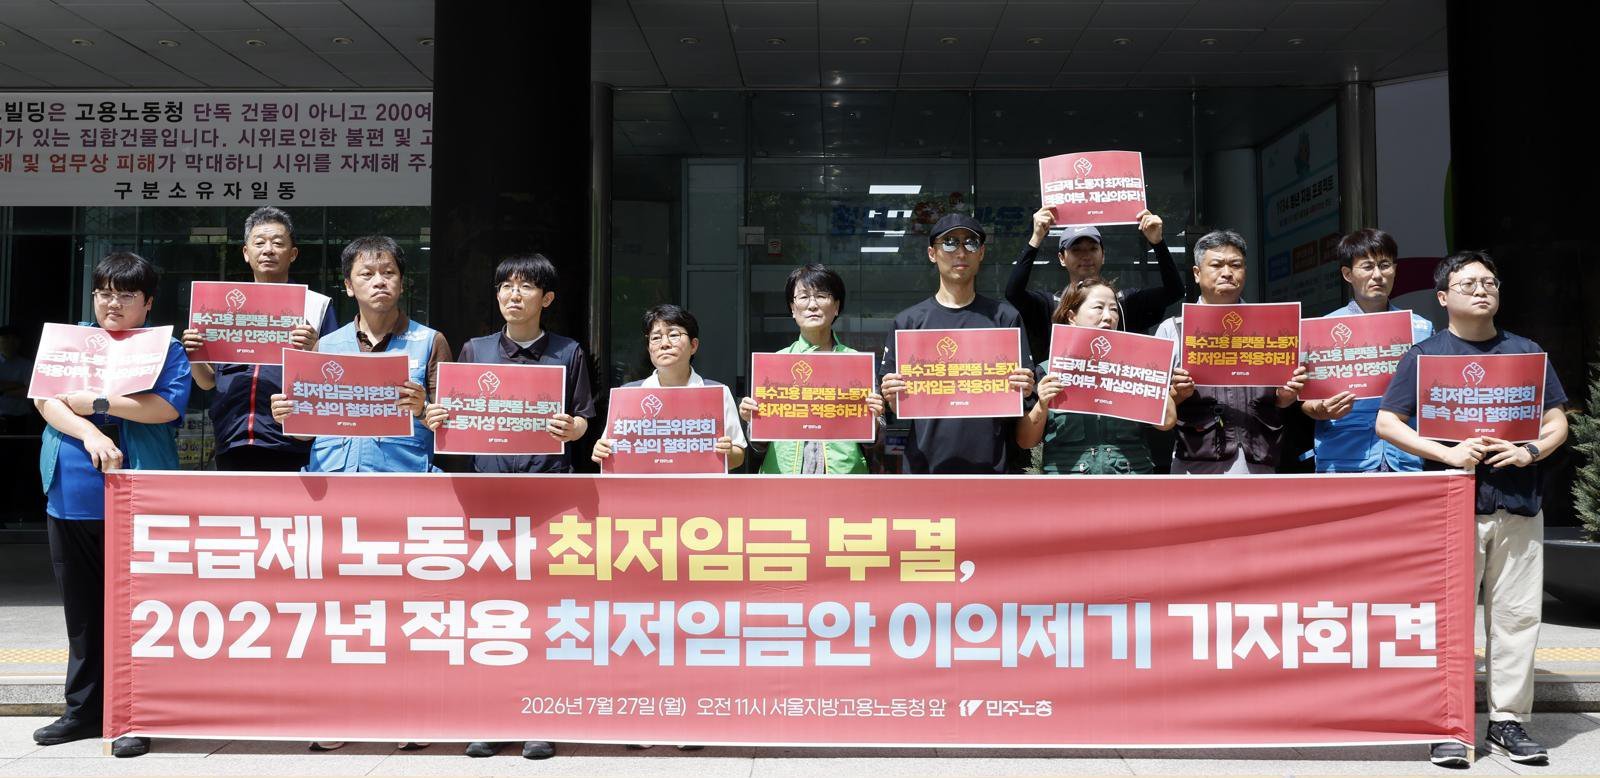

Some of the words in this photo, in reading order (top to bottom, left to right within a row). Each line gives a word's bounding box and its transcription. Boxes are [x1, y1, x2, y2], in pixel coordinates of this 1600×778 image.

[0, 102, 67, 123] 빌딩은
[74, 102, 183, 123] 고용노동청
[194, 103, 232, 122] 단독
[241, 103, 299, 122] 건물이
[309, 103, 367, 122] 아니고
[375, 103, 432, 121] 200여
[0, 128, 23, 147] 가
[33, 128, 70, 147] 있는
[80, 128, 227, 147] 집합건물입니다.
[238, 128, 337, 147] 시위로인한
[346, 128, 384, 147] 불편
[394, 128, 411, 147] 및
[22, 154, 39, 173] 및
[49, 154, 108, 173] 업무상
[116, 153, 176, 173] 피해가
[185, 154, 263, 173] 막대하니
[273, 154, 331, 173] 시위를
[340, 153, 399, 173] 자제해
[407, 154, 432, 172] 주
[1045, 179, 1073, 192] 도급제
[1074, 178, 1104, 190] 노동자
[1104, 177, 1142, 189] 최저임금
[192, 312, 234, 327] 특수고용
[236, 314, 268, 327] 플랫폼
[270, 315, 304, 328] 노동자
[1185, 335, 1229, 349] 특수고용
[1231, 335, 1265, 349] 플랫폼
[1265, 335, 1298, 349] 노동자
[1188, 352, 1238, 366] 최저임금
[1344, 346, 1377, 361] 플랫폼
[900, 363, 946, 377] 특수고용
[948, 363, 982, 377] 플랫폼
[984, 362, 1018, 376] 노동자
[1052, 356, 1086, 371] 도급제
[1086, 359, 1121, 376] 노동자
[1122, 365, 1168, 384] 최저임금
[293, 381, 400, 401] 최저임금위원회
[755, 386, 800, 400] 특수고용
[801, 387, 836, 401] 플랫폼
[837, 387, 871, 401] 노동자
[905, 379, 955, 395] 최저임금
[958, 379, 1013, 394] 적용하라
[1430, 385, 1535, 405] 최저임금위원회
[315, 401, 343, 417] 심의
[440, 397, 486, 411] 특수고용
[488, 398, 523, 413] 플랫폼
[525, 401, 561, 415] 노동자
[758, 403, 808, 418] 최저임금
[1421, 404, 1450, 420] 졸속
[1453, 406, 1483, 422] 심의
[442, 415, 495, 431] 노동자성
[613, 418, 716, 436] 최저임금위원회
[633, 438, 660, 454] 심의
[130, 514, 323, 579] 도급제
[338, 516, 537, 581] 노동자
[547, 515, 811, 581] 최저임금
[826, 517, 976, 583] 부결,
[131, 599, 387, 664] 2027년
[401, 599, 532, 666] 적용
[544, 599, 876, 667] 최저임금안
[888, 601, 1152, 669] 이의제기
[1167, 601, 1437, 669] 기자회견
[521, 697, 582, 715] 2026년
[586, 697, 613, 715] 7월
[616, 697, 655, 715] 27일
[658, 697, 686, 716] (월)
[696, 697, 731, 716] 오전
[735, 697, 767, 716] 11시
[769, 697, 925, 717] 서울지방고용노동청
[929, 697, 946, 717] 앞
[986, 699, 1052, 717] 민주노총
